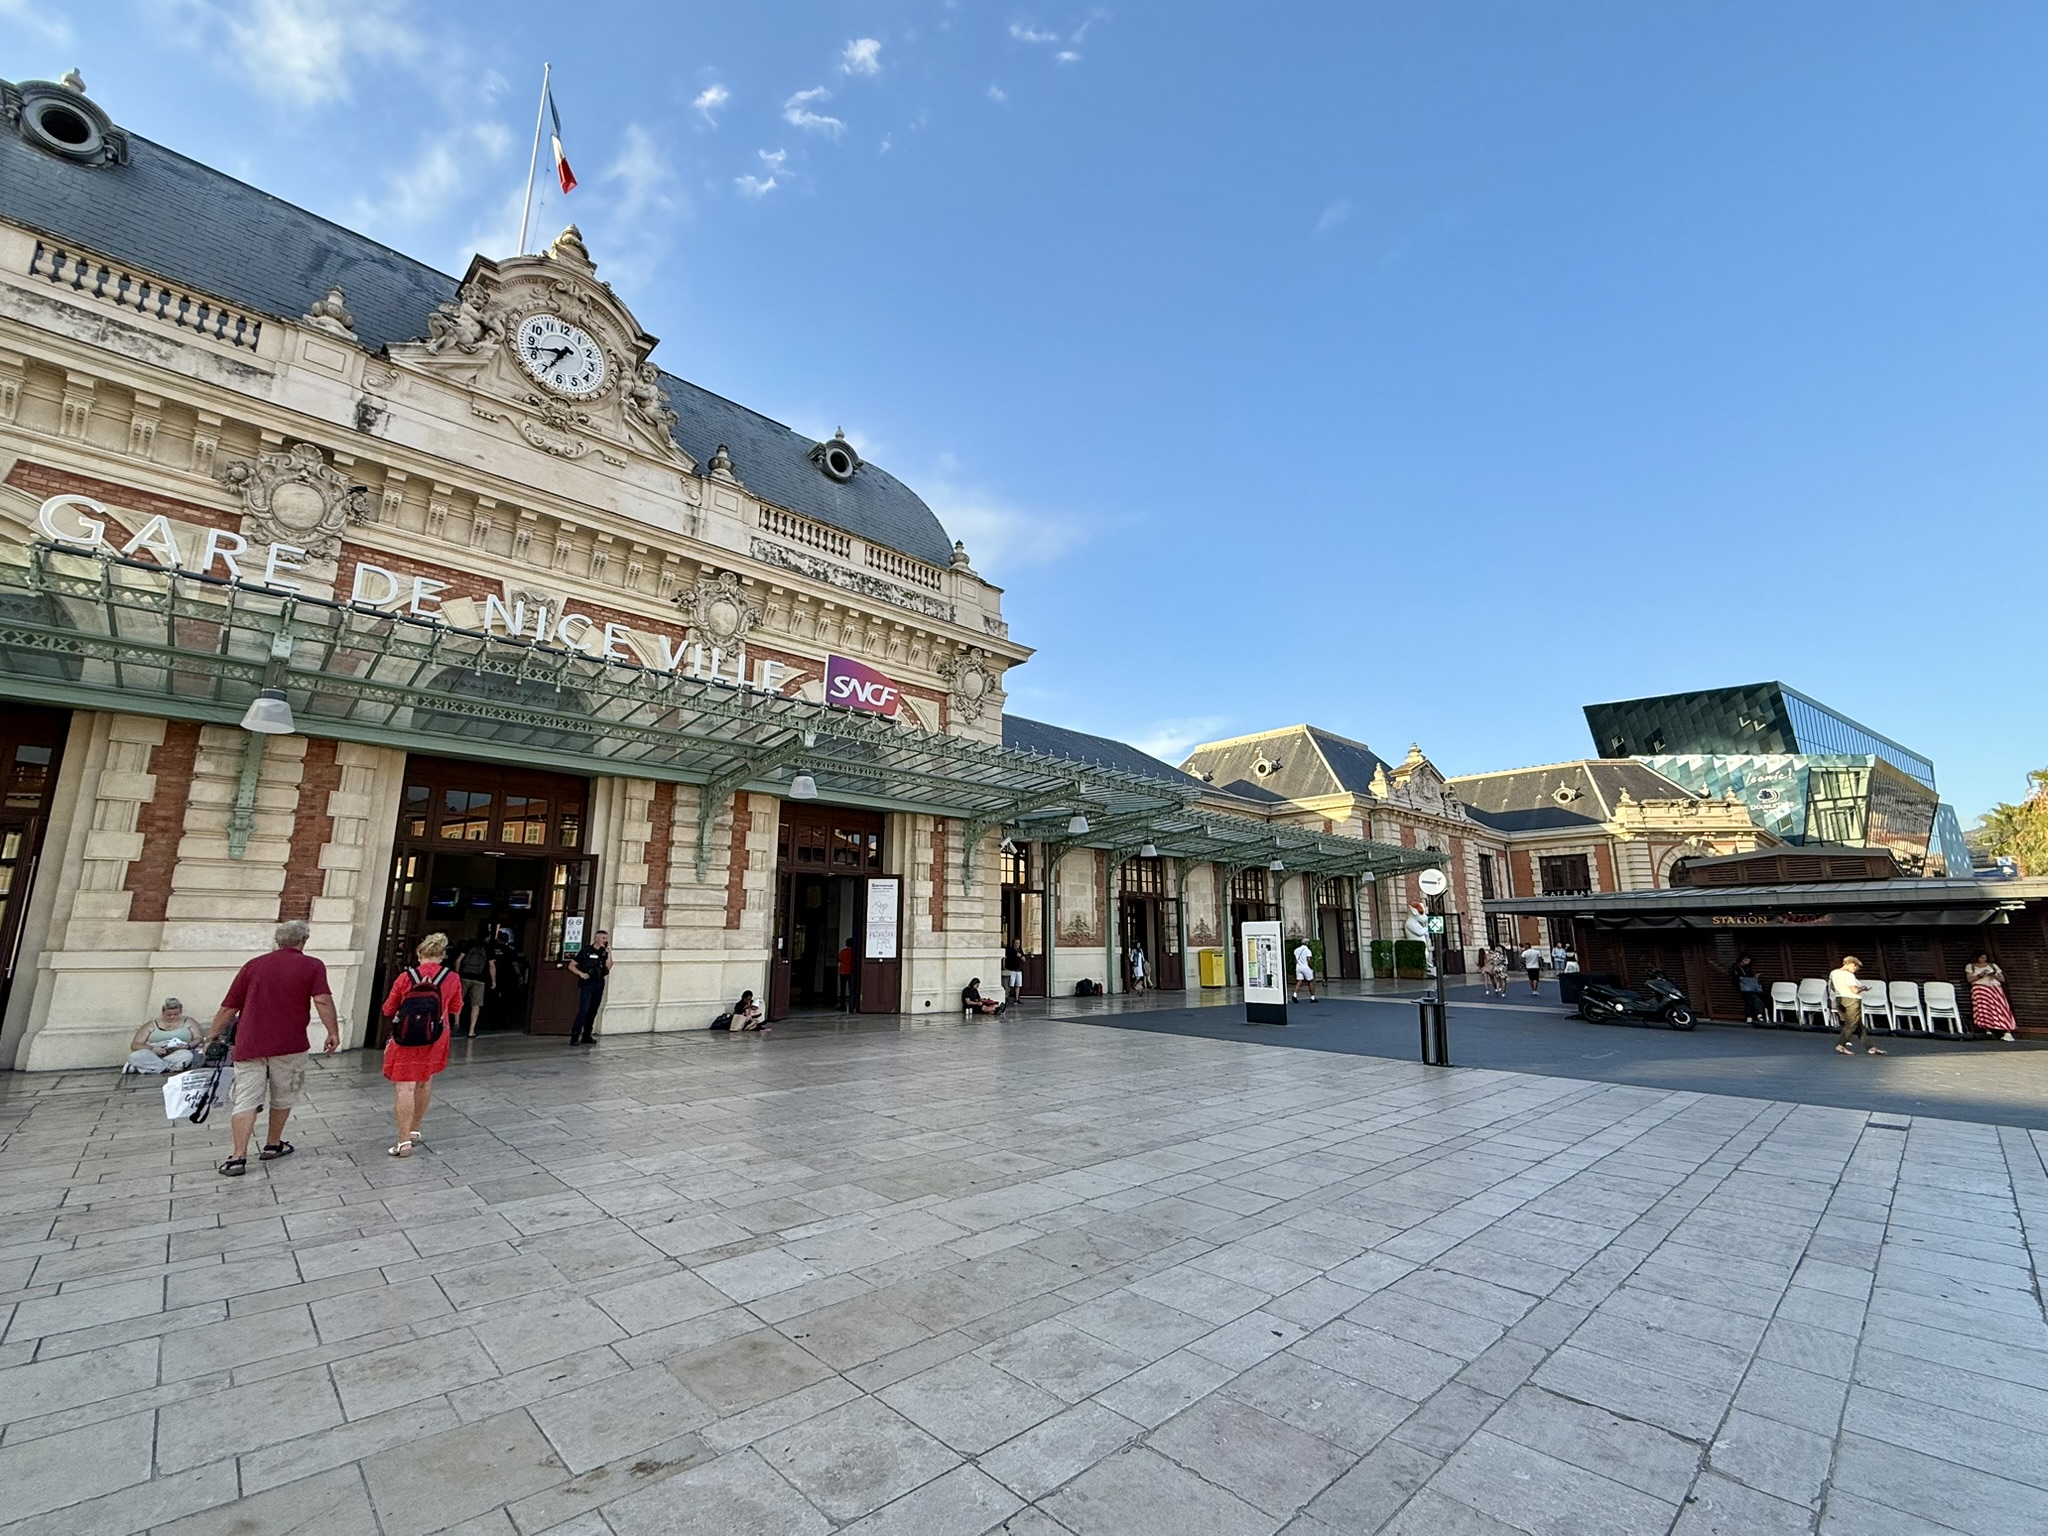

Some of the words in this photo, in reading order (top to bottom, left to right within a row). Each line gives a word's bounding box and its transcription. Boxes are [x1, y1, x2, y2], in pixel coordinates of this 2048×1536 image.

[531, 325, 542, 336] 10
[546, 322, 554, 332] 11
[561, 325, 570, 336] 12
[527, 336, 536, 346] 9
[530, 350, 538, 360] 8
[586, 349, 593, 359] 2
[541, 364, 548, 373] 7
[588, 362, 595, 373] 3
[555, 374, 563, 384] 6
[571, 377, 578, 387] 5
[583, 374, 590, 382] 4
[39, 494, 306, 589] GARE
[352, 562, 446, 619] DE
[484, 594, 631, 660] NICE
[659, 635, 785, 692] VILLE
[829, 676, 899, 707] SNCF
[1543, 889, 1568, 897] CAFÉ
[1712, 916, 1768, 925] STATION
